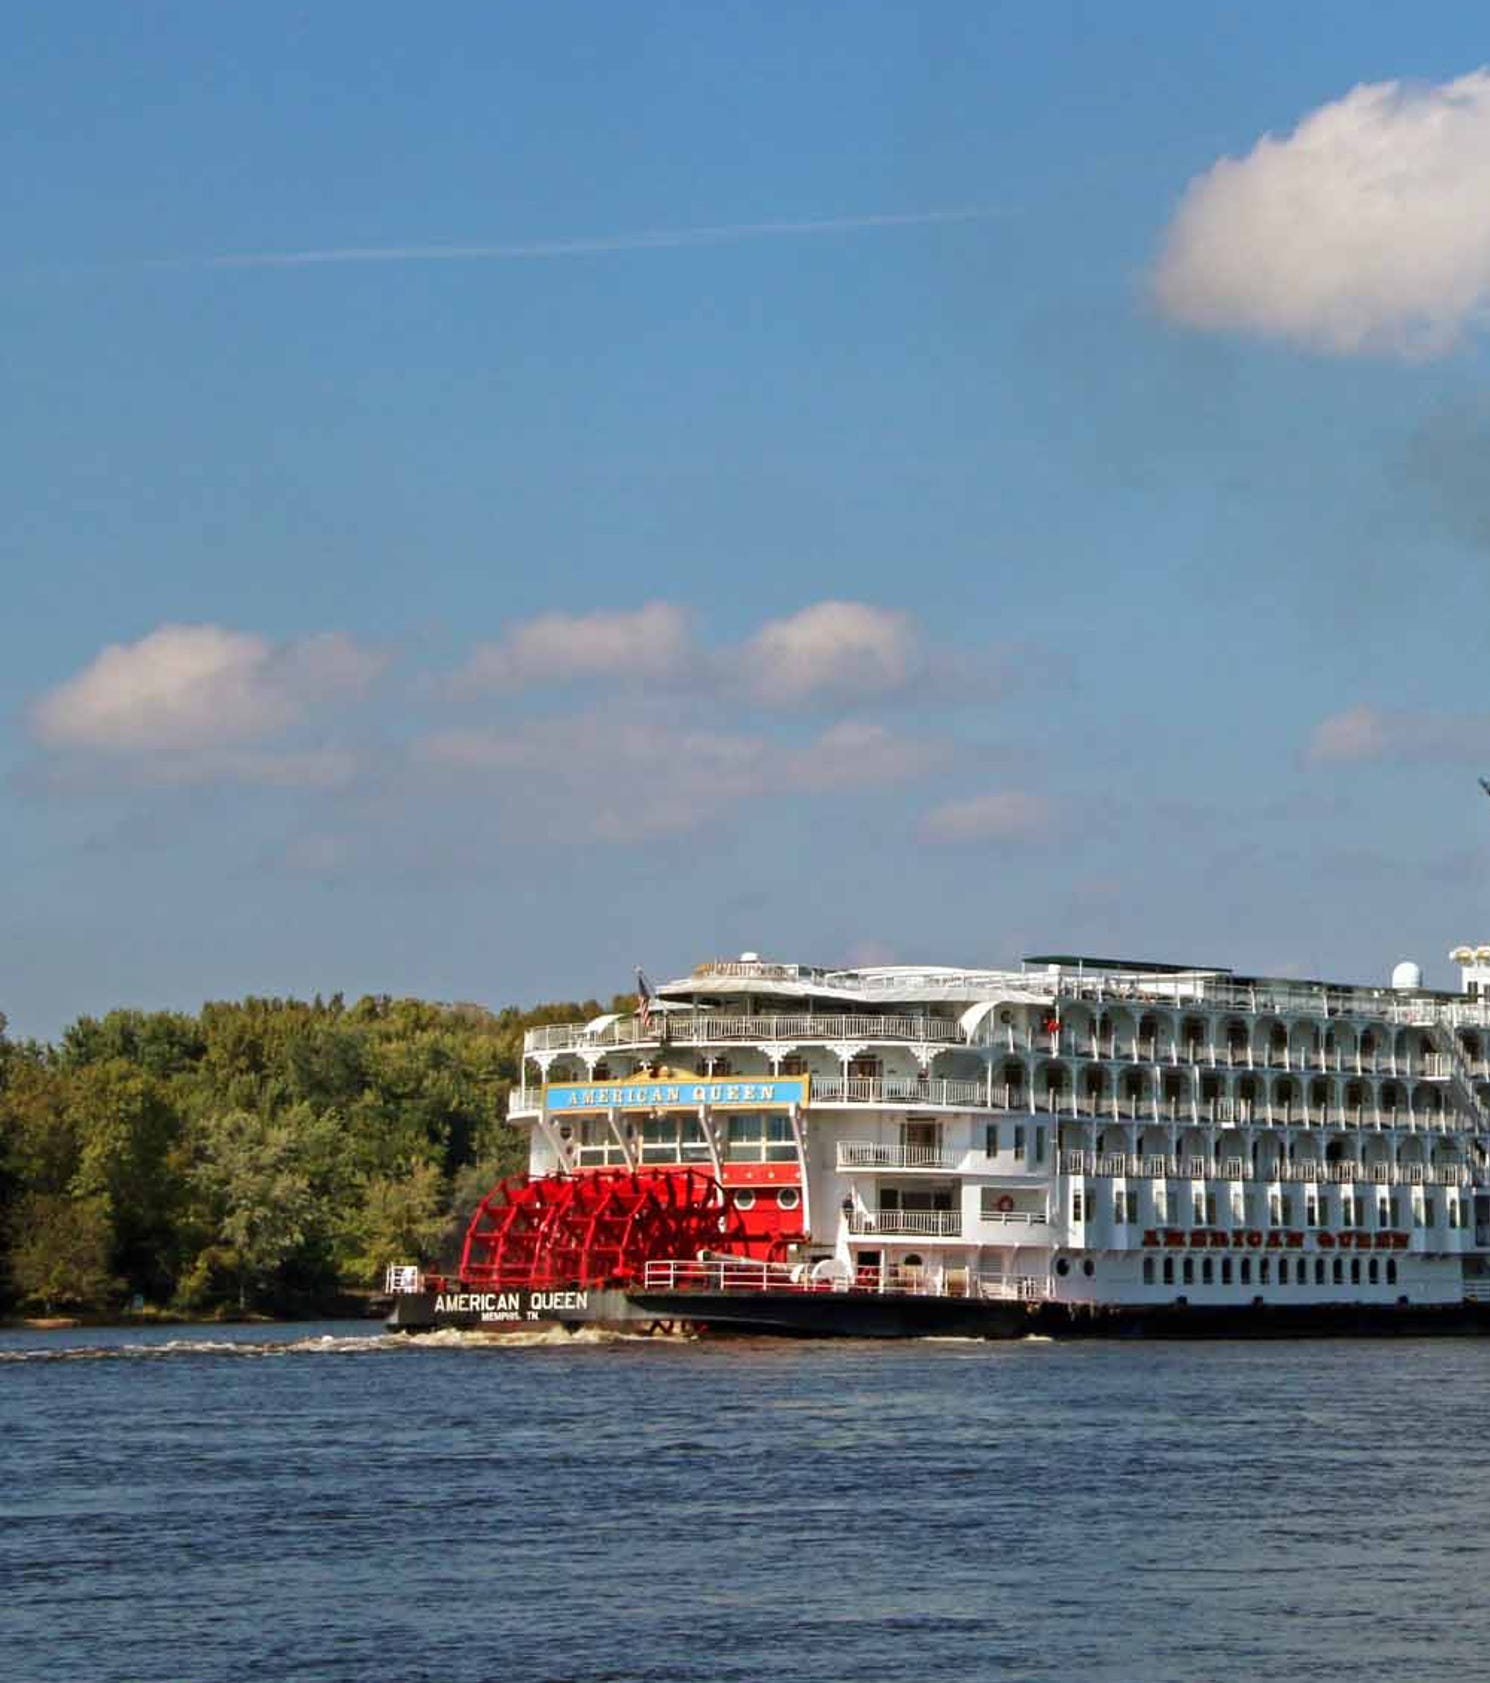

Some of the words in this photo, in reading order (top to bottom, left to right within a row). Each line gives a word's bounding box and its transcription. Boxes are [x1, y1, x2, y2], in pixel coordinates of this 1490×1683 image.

[569, 1087, 680, 1106] AMERICAN
[692, 1084, 775, 1101] QUEEN
[1143, 1230, 1304, 1248] AMERICAN
[1317, 1231, 1410, 1248] QUEEN
[434, 1293, 520, 1312] AMERICAN
[531, 1291, 588, 1310] QUEEN
